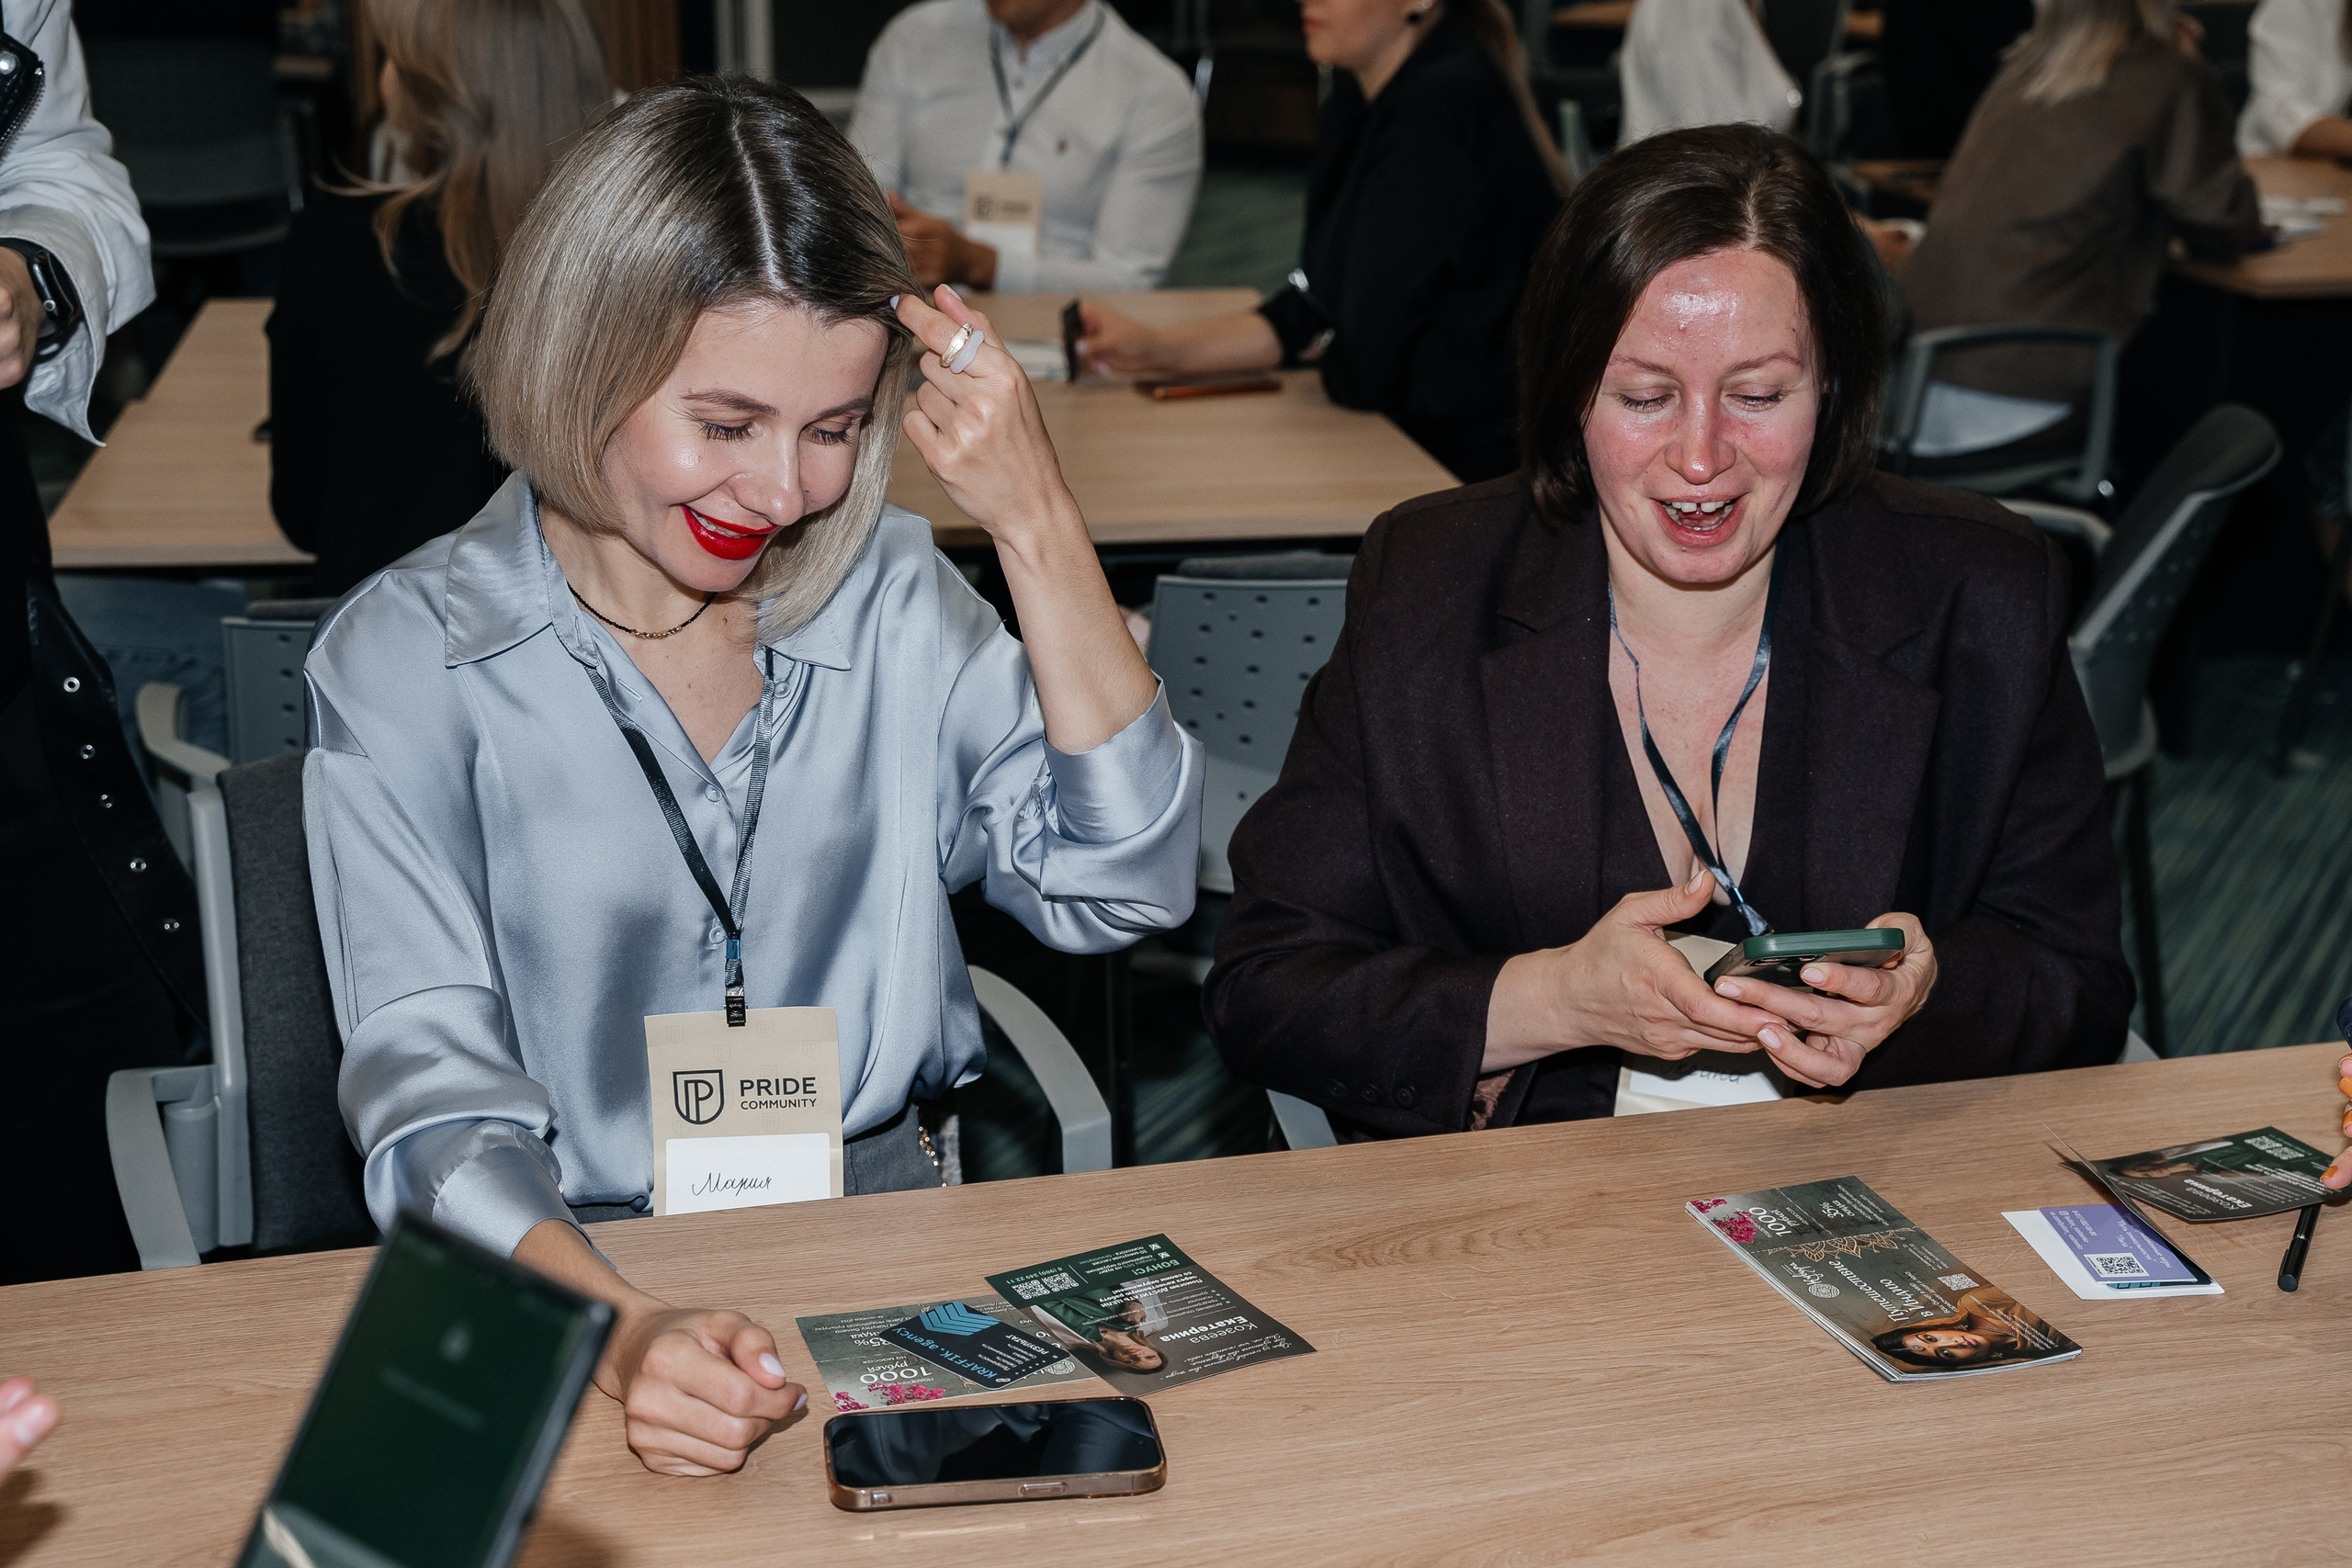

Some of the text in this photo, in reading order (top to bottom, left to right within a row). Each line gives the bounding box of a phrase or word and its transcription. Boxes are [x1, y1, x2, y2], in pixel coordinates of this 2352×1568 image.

[740, 1077, 817, 1097] PRIDE
[741, 1099, 817, 1110] COMMUNITY
[691, 1172, 773, 1196] Мария
[2184, 1179, 2252, 1208] Екатерина
[1770, 1210, 1799, 1226] рублей
[1819, 1202, 1844, 1218] 35%
[1833, 1201, 1855, 1216] скидка
[1748, 1207, 1792, 1236] 1000
[1132, 1259, 1180, 1275] БОНУС!
[1096, 1292, 1125, 1303] работу
[1098, 1278, 1204, 1308] Помогаю ДОСТИГАТЬ ЦЕЛИ
[1123, 1280, 1177, 1296] качественную
[1829, 1261, 1909, 1322] Путешествие
[1881, 1280, 1925, 1311] Индию
[1159, 1316, 1248, 1341] Екатерина
[1190, 1323, 1257, 1343] Козеева
[892, 1328, 997, 1378] KRAFFIK.agency
[1006, 1335, 1048, 1354] РЕЗУЛЬТАТ
[860, 1367, 932, 1383] 1000
[866, 1360, 908, 1373] рублей
